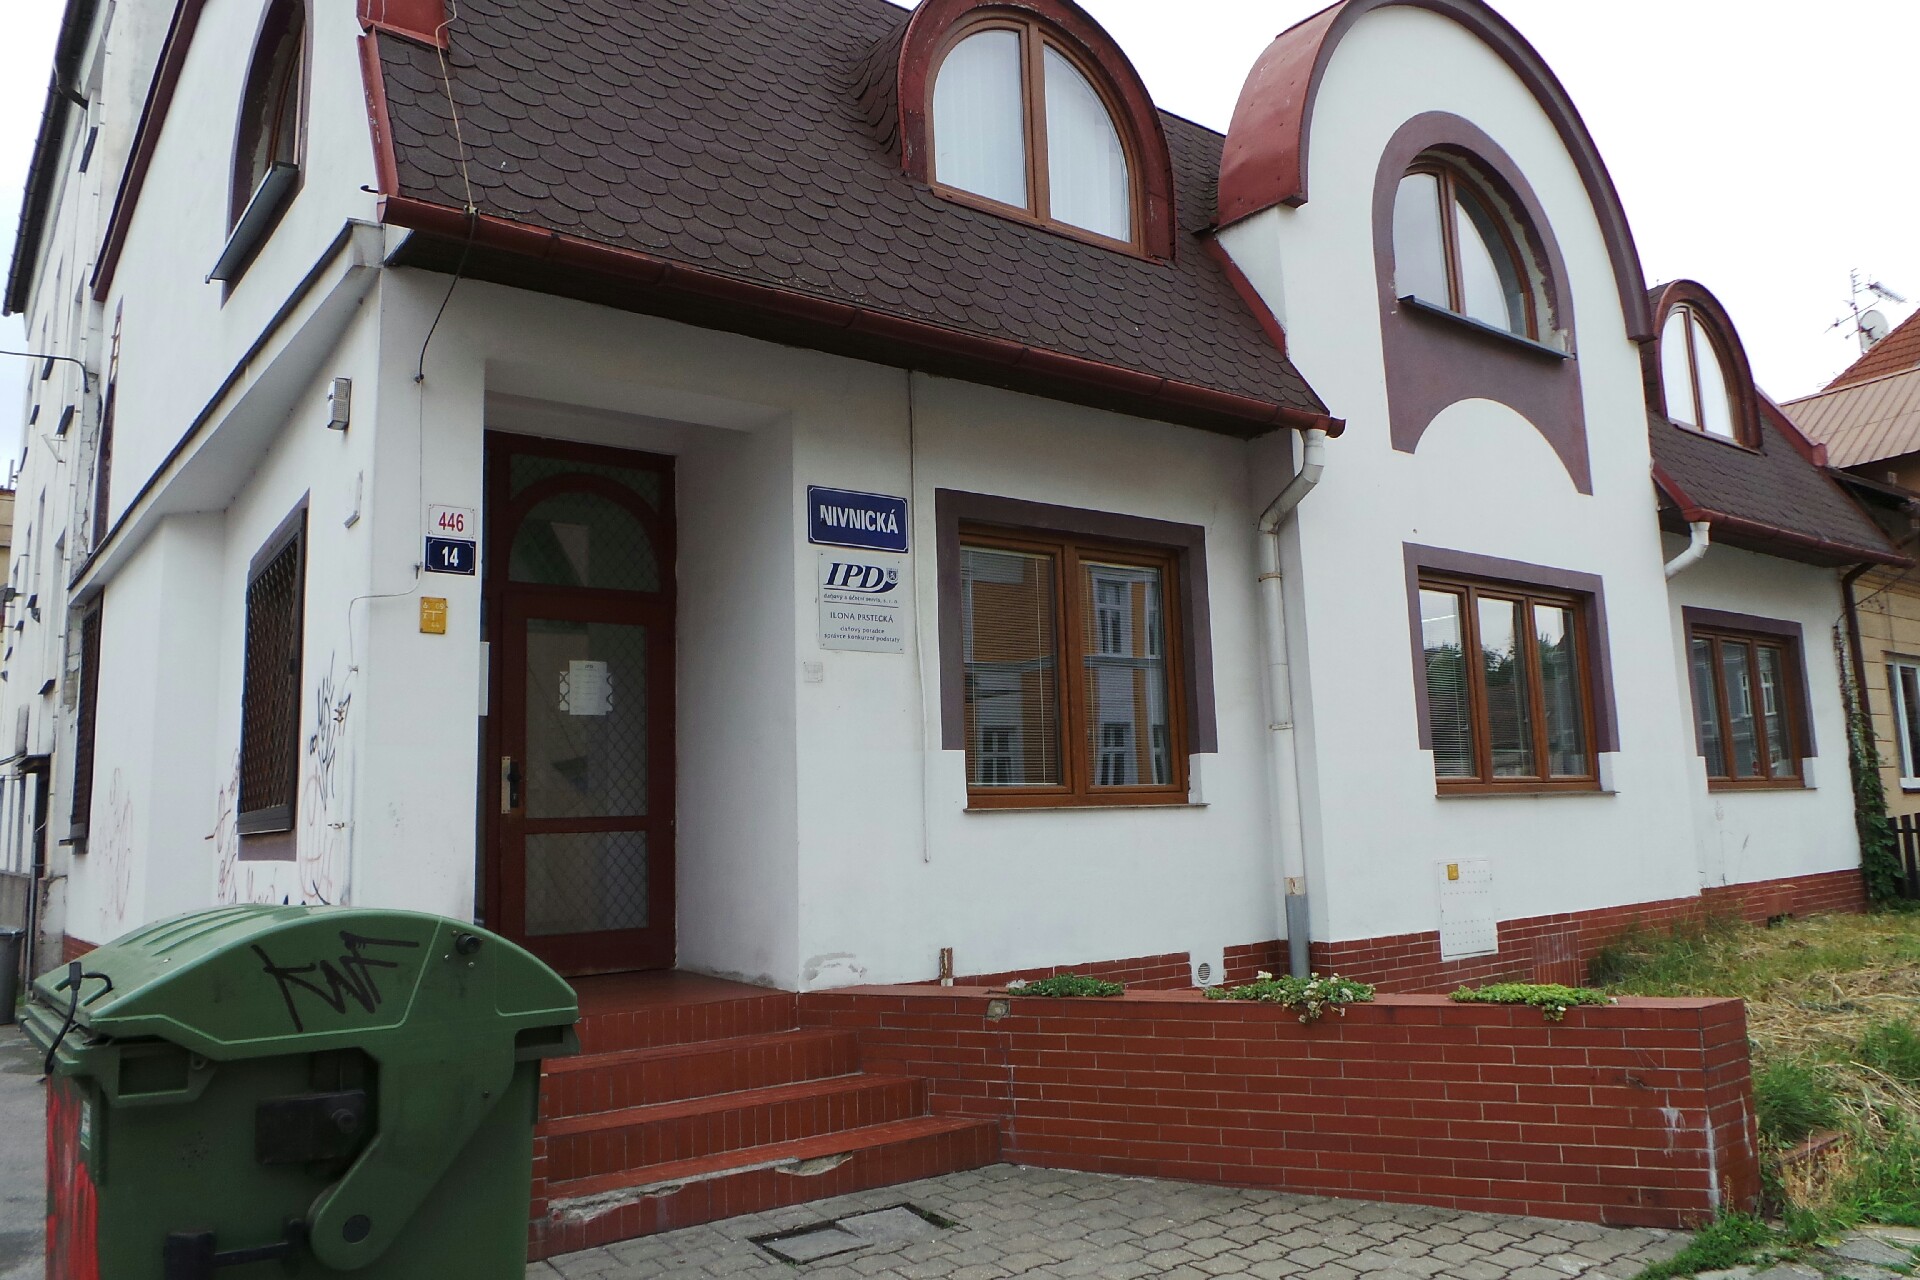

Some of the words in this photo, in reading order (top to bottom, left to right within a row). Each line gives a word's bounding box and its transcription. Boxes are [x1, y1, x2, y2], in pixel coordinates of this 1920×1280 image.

[438, 511, 464, 532] 446
[820, 504, 899, 534] NIVNICKÁ
[442, 546, 459, 567] 14
[823, 562, 885, 589] IPD
[830, 611, 855, 620] ILONA
[857, 613, 894, 624] PRSTECKÁ
